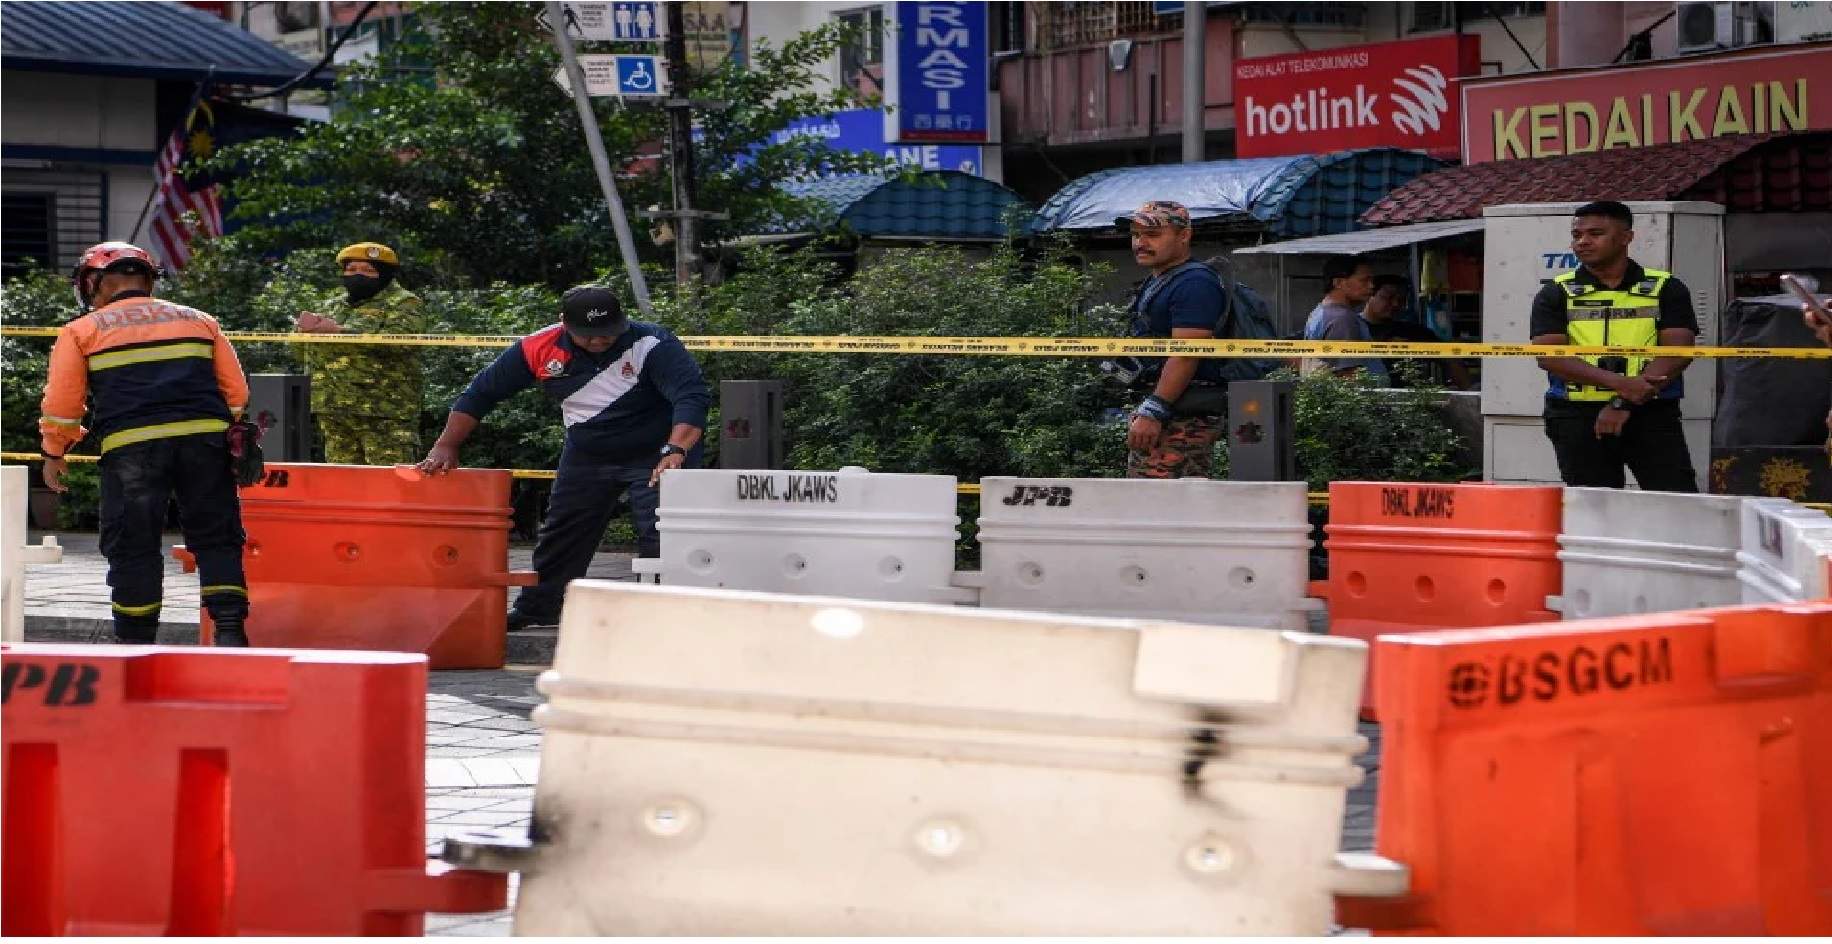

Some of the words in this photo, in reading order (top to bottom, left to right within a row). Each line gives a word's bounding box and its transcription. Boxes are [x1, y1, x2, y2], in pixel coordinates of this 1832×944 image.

[917, 2, 970, 110] RMASI
[1245, 84, 1380, 137] hotlink
[1493, 93, 1653, 161] KEDAI
[1669, 78, 1808, 144] KAIN
[736, 474, 780, 501] DBKL
[782, 474, 837, 503] JKAWS
[1002, 485, 1074, 507] JPB
[1381, 487, 1412, 517] DBKL
[1499, 638, 1672, 705] BSGCM
